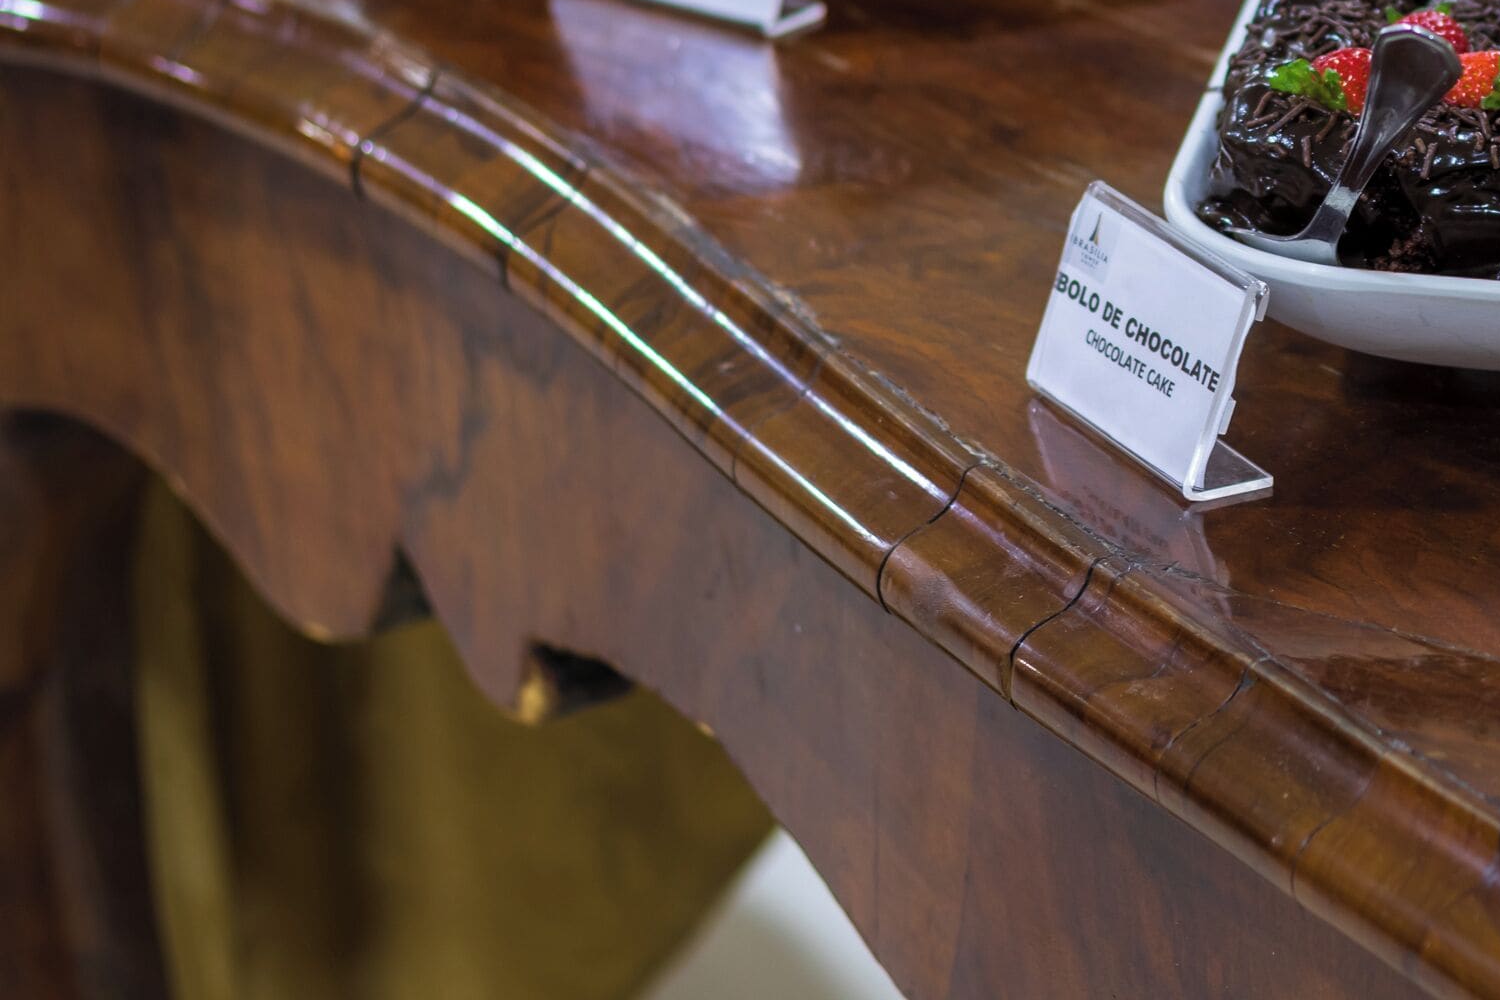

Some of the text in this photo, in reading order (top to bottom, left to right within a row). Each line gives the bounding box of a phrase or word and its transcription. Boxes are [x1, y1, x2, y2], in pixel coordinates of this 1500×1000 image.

[1056, 271, 1221, 393] BOLO DE CHOCOLATE
[1086, 329, 1176, 398] CHOCOLATE CAKE
